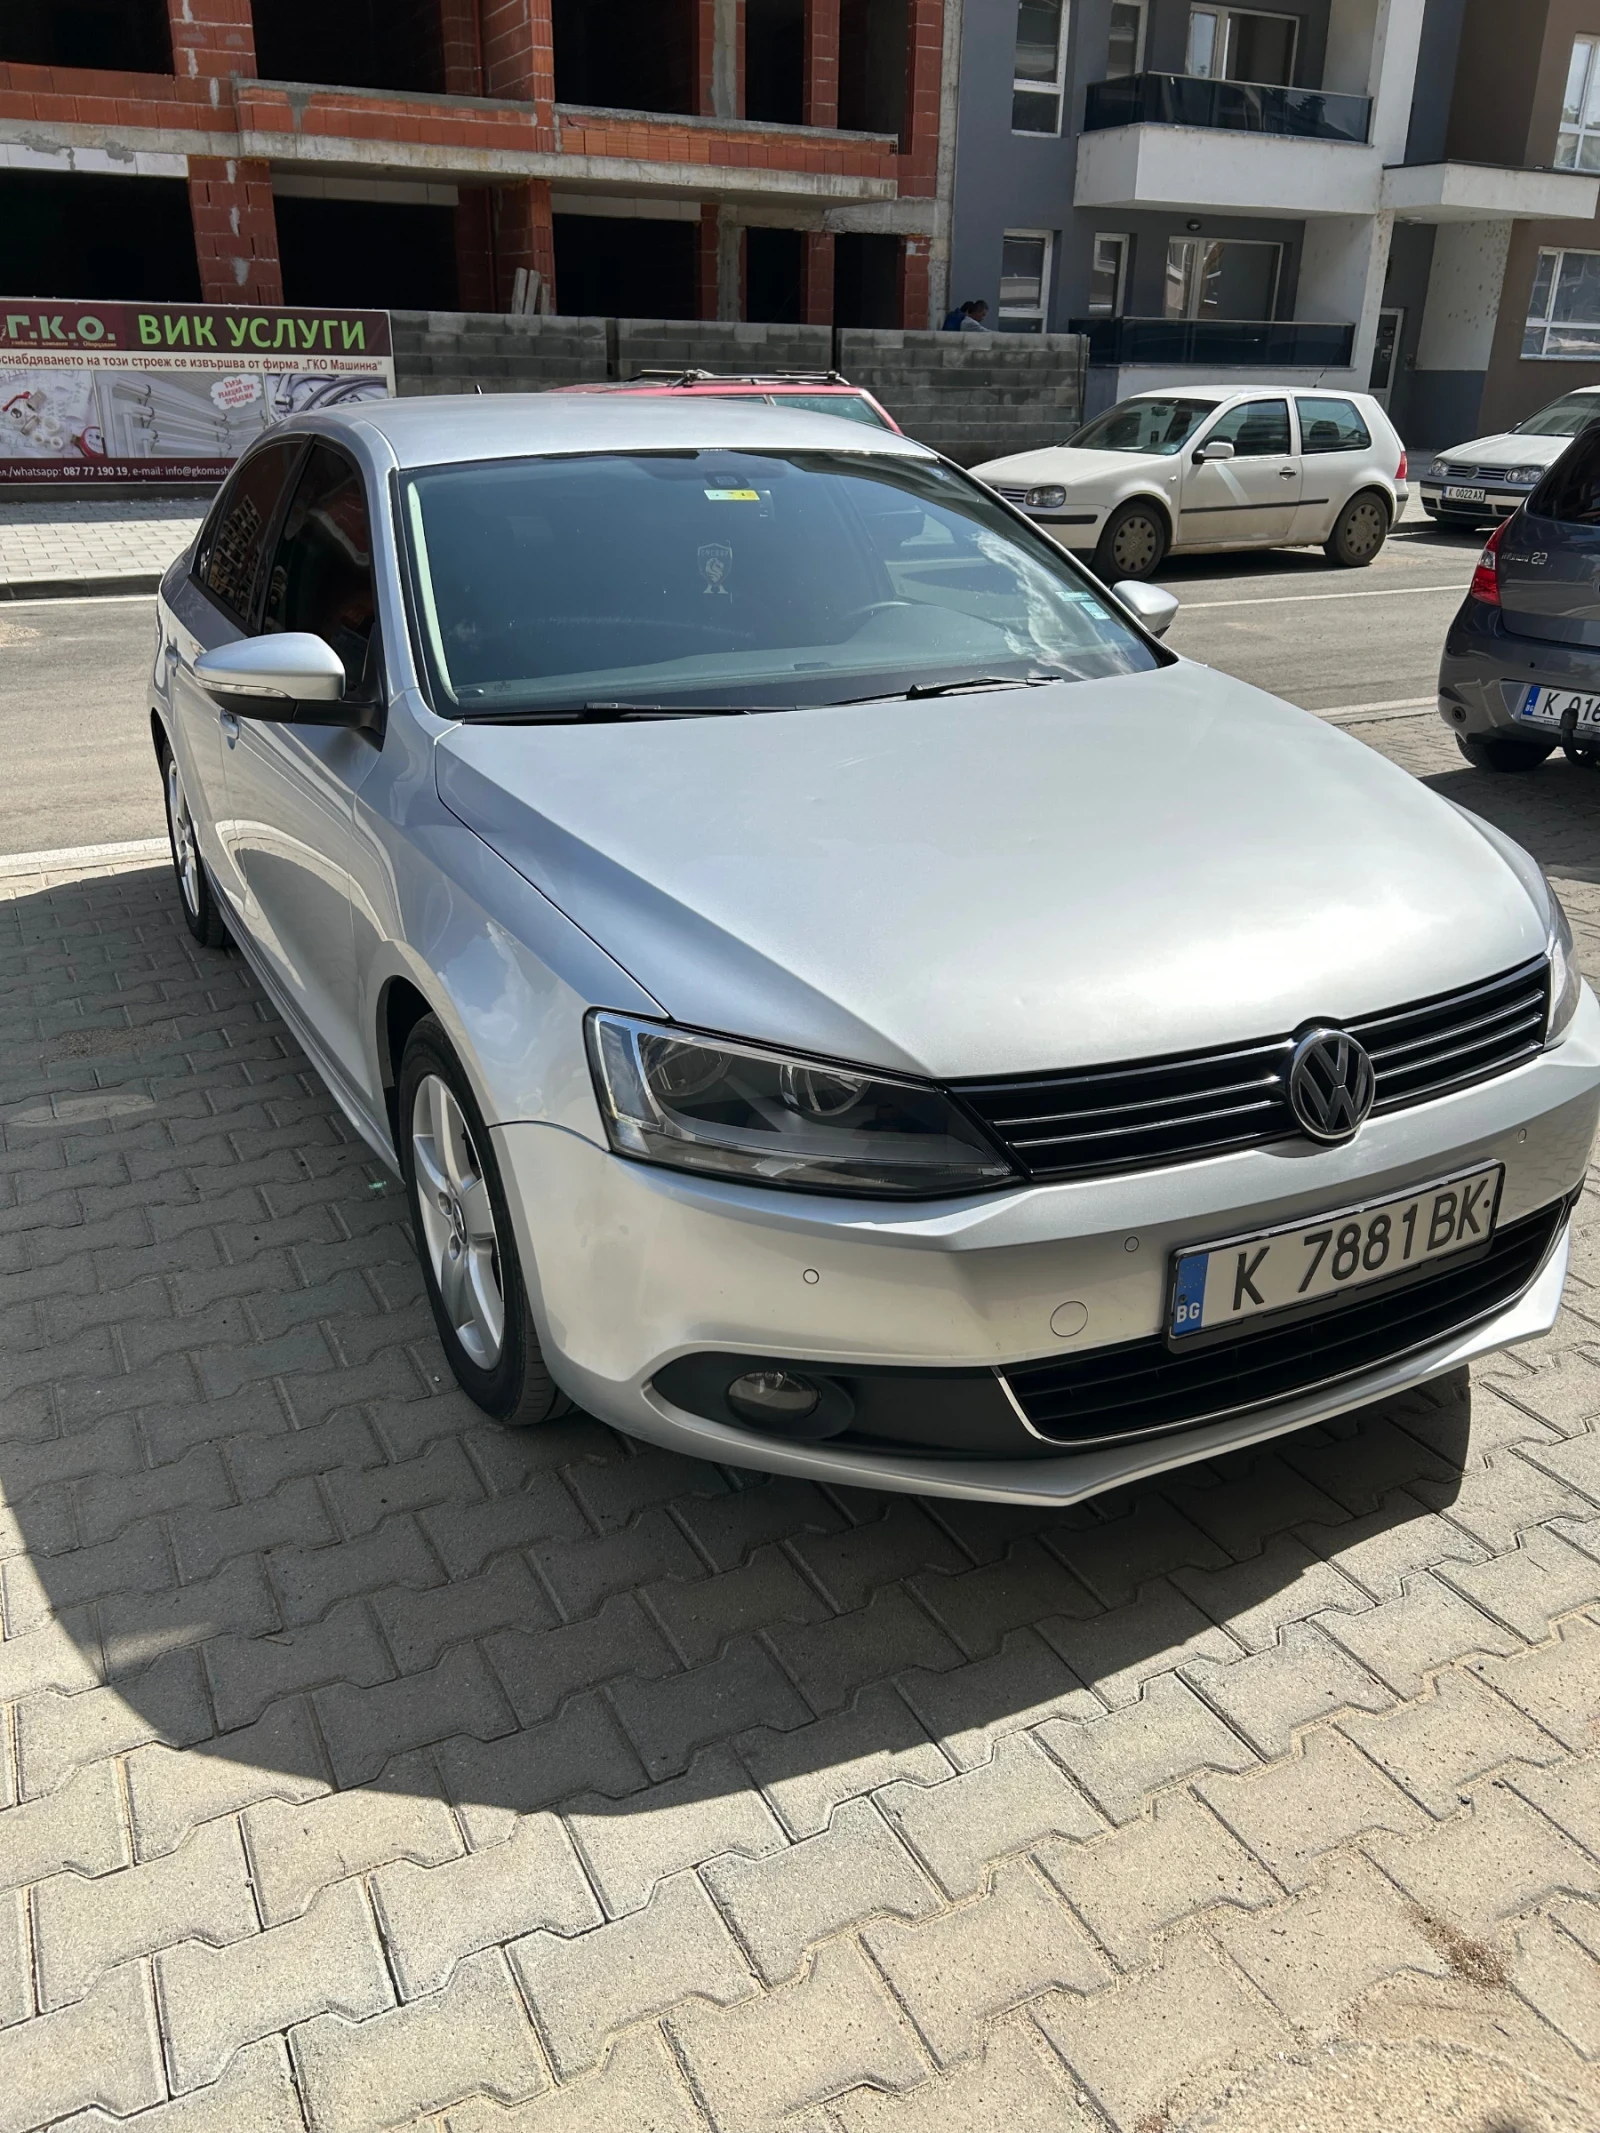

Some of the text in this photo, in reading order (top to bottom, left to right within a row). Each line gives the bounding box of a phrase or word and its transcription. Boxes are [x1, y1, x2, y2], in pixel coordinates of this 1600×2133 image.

[6, 315, 116, 341] Г.К.О.
[138, 314, 366, 350] ВИК УСЛУГИ
[0, 353, 84, 366] снабдяването
[87, 356, 101, 366] на
[103, 356, 129, 366] този
[132, 356, 172, 369] строеж
[174, 357, 187, 367] се
[191, 358, 245, 370] извършва
[248, 360, 260, 369] от
[263, 358, 299, 371] фирма
[64, 467, 80, 476] 087
[83, 467, 94, 476] 77
[97, 467, 114, 476] 190
[133, 466, 163, 476] e-mail:
[1542, 692, 1561, 716] K
[1232, 1179, 1489, 1311] K 7881 BK
[1176, 1302, 1200, 1323] BG
